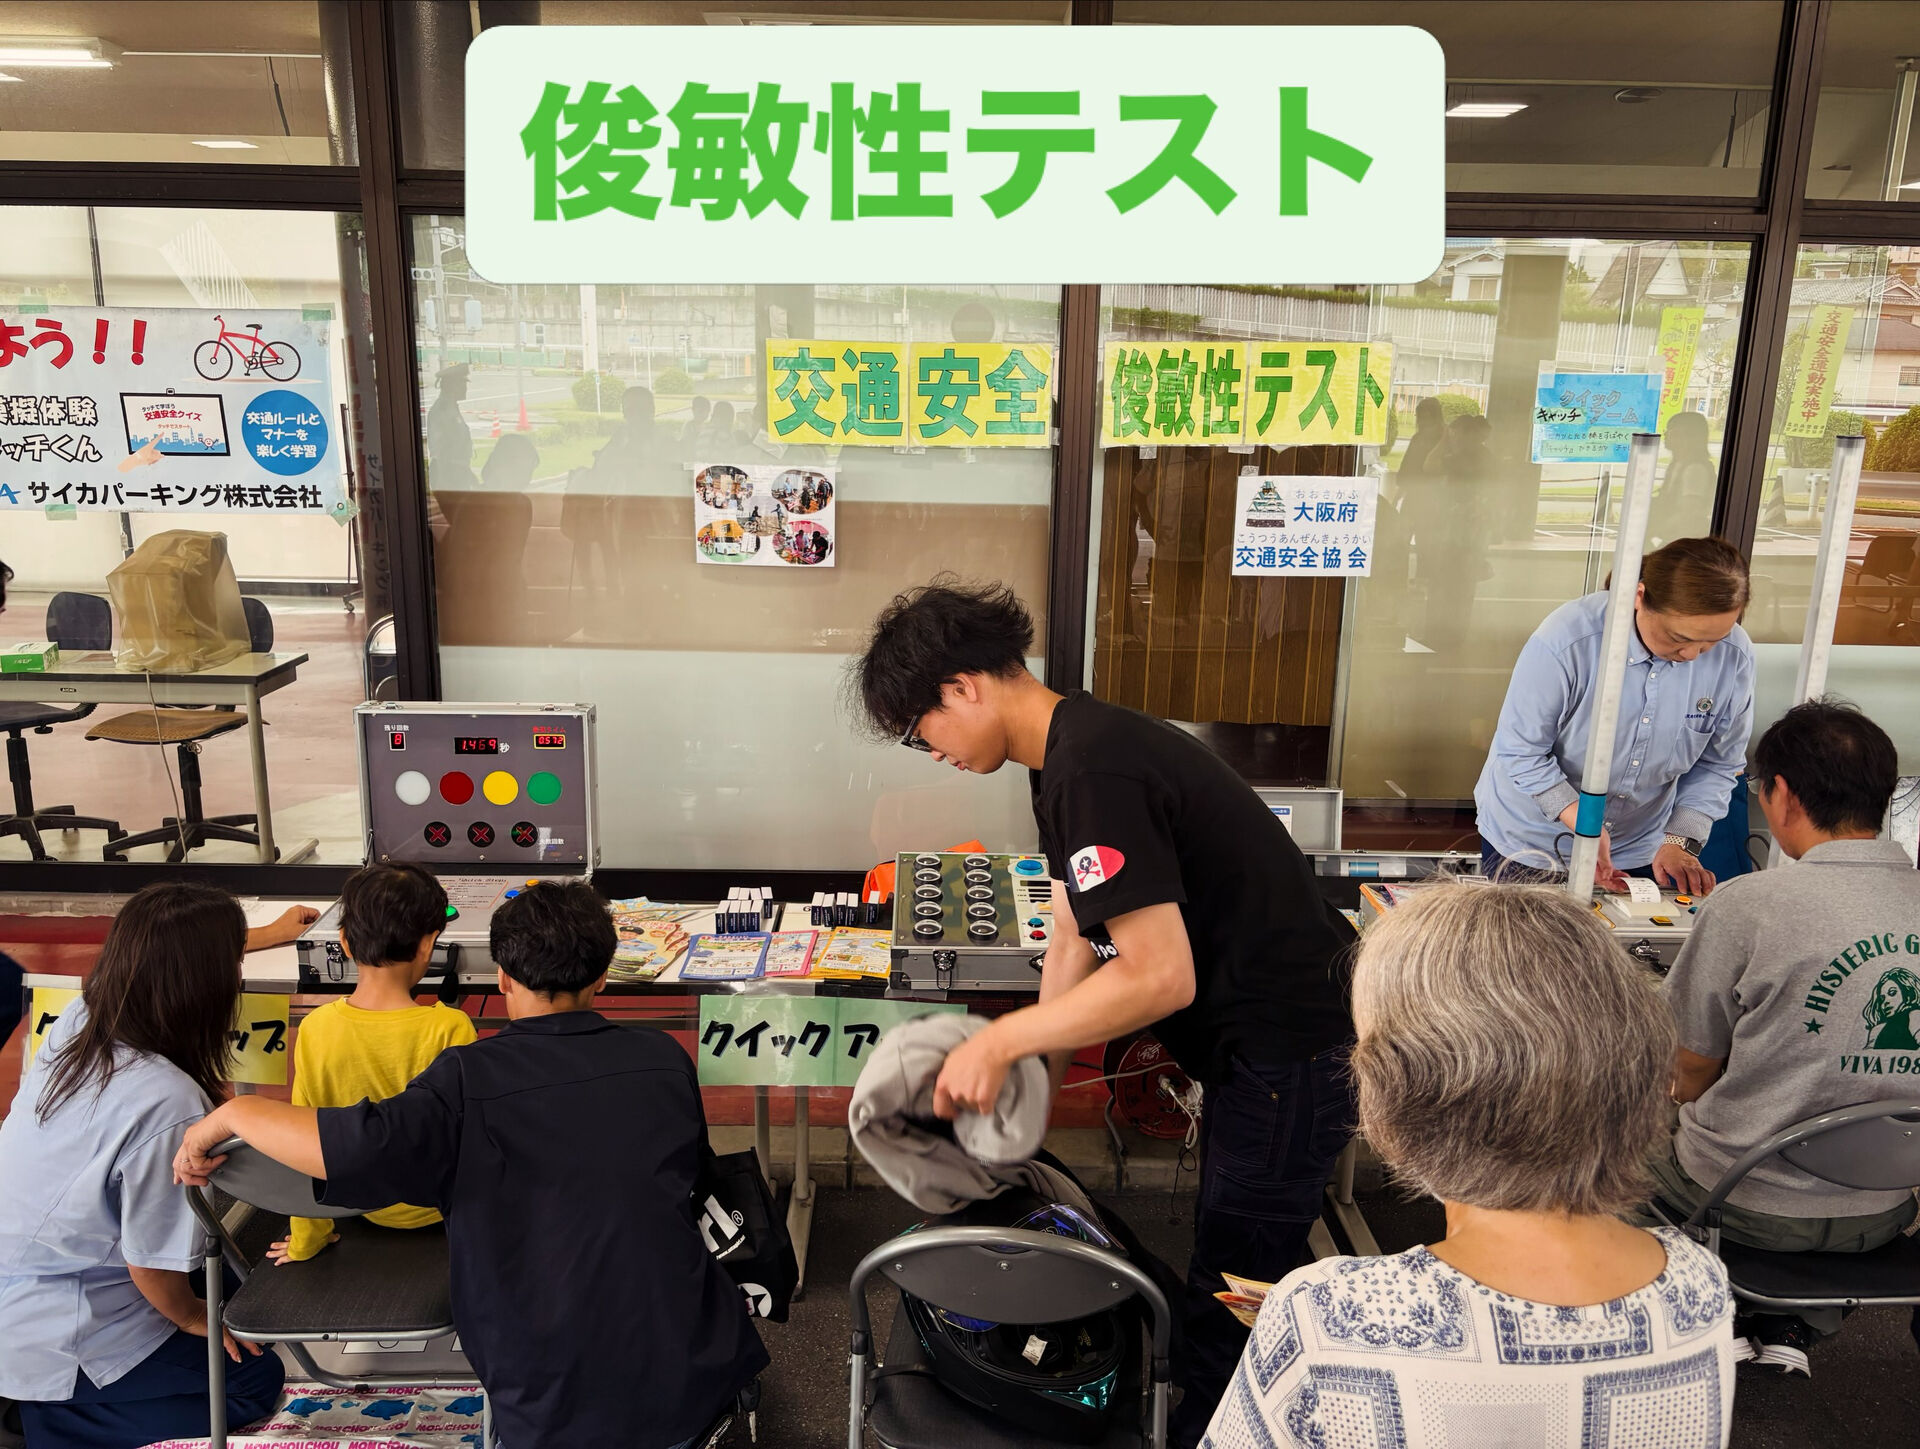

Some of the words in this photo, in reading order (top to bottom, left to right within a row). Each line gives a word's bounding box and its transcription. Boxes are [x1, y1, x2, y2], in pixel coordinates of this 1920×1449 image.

[1801, 311, 1842, 422] 交通安全運動実施中
[773, 347, 1046, 438] 交通安全
[1112, 347, 1385, 438] 俊敏性テスト
[1560, 389, 1621, 407] クイック
[144, 410, 203, 421] 交通安全クイズ
[246, 411, 321, 426] 交通ルールと
[1537, 408, 1581, 422] キャッチ
[260, 428, 309, 441] マナーを
[0, 434, 103, 463] ッチくん
[256, 444, 317, 458] 楽しく学習
[28, 481, 323, 508] サイカパーキング株式会社
[1293, 501, 1358, 523] 大阪府
[1237, 533, 1372, 544] こうつうあんぜんきょうかい
[1235, 546, 1368, 569] 交通安全協会
[1804, 932, 1898, 1014] HYSTERIC
[701, 1020, 880, 1058] クイックア
[1840, 1055, 1883, 1074] VIVA
